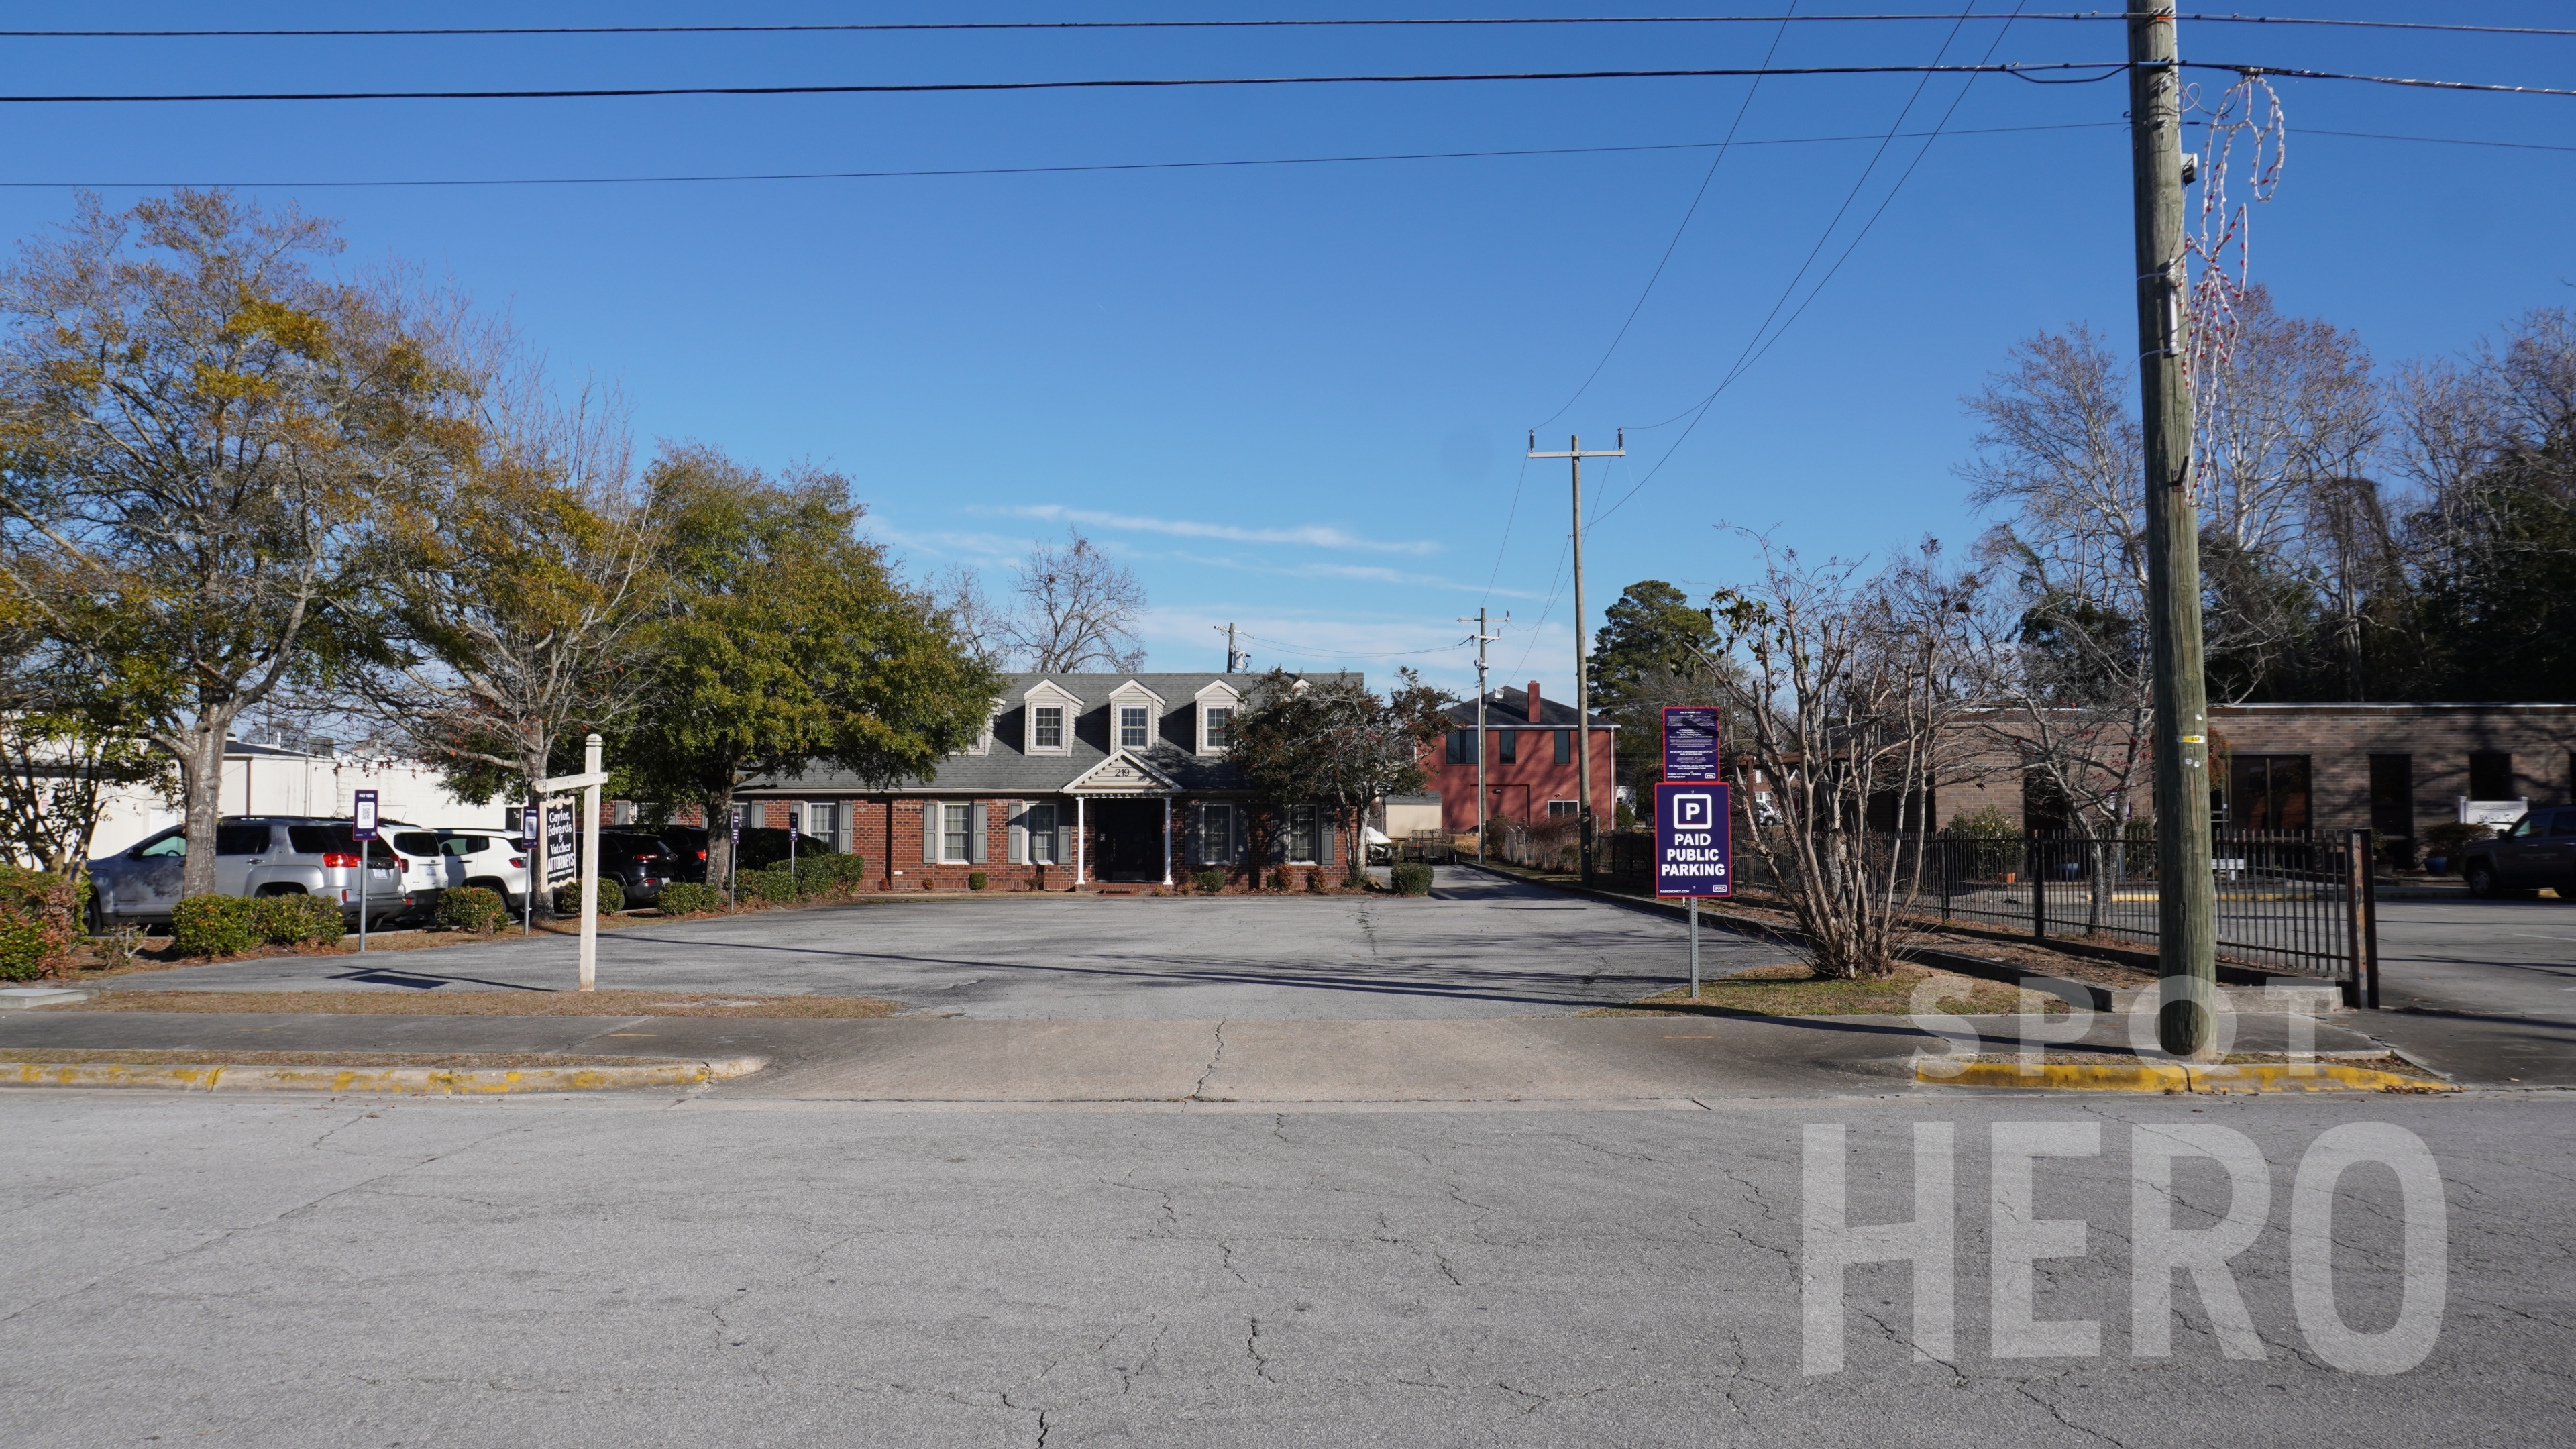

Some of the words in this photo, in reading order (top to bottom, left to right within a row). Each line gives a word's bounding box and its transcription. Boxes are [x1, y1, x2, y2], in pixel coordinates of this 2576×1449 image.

[1114, 768, 1130, 777] 219
[549, 809, 570, 826] Gaylor,
[1686, 803, 1700, 820] P
[547, 821, 572, 837] Edwards
[558, 833, 563, 843] &
[1674, 833, 1711, 845] PAID
[550, 841, 572, 855] Vatcher
[1667, 849, 1719, 861] PUBLIC
[547, 853, 574, 872] ATTORNEYS
[1662, 863, 1725, 876] PARKING
